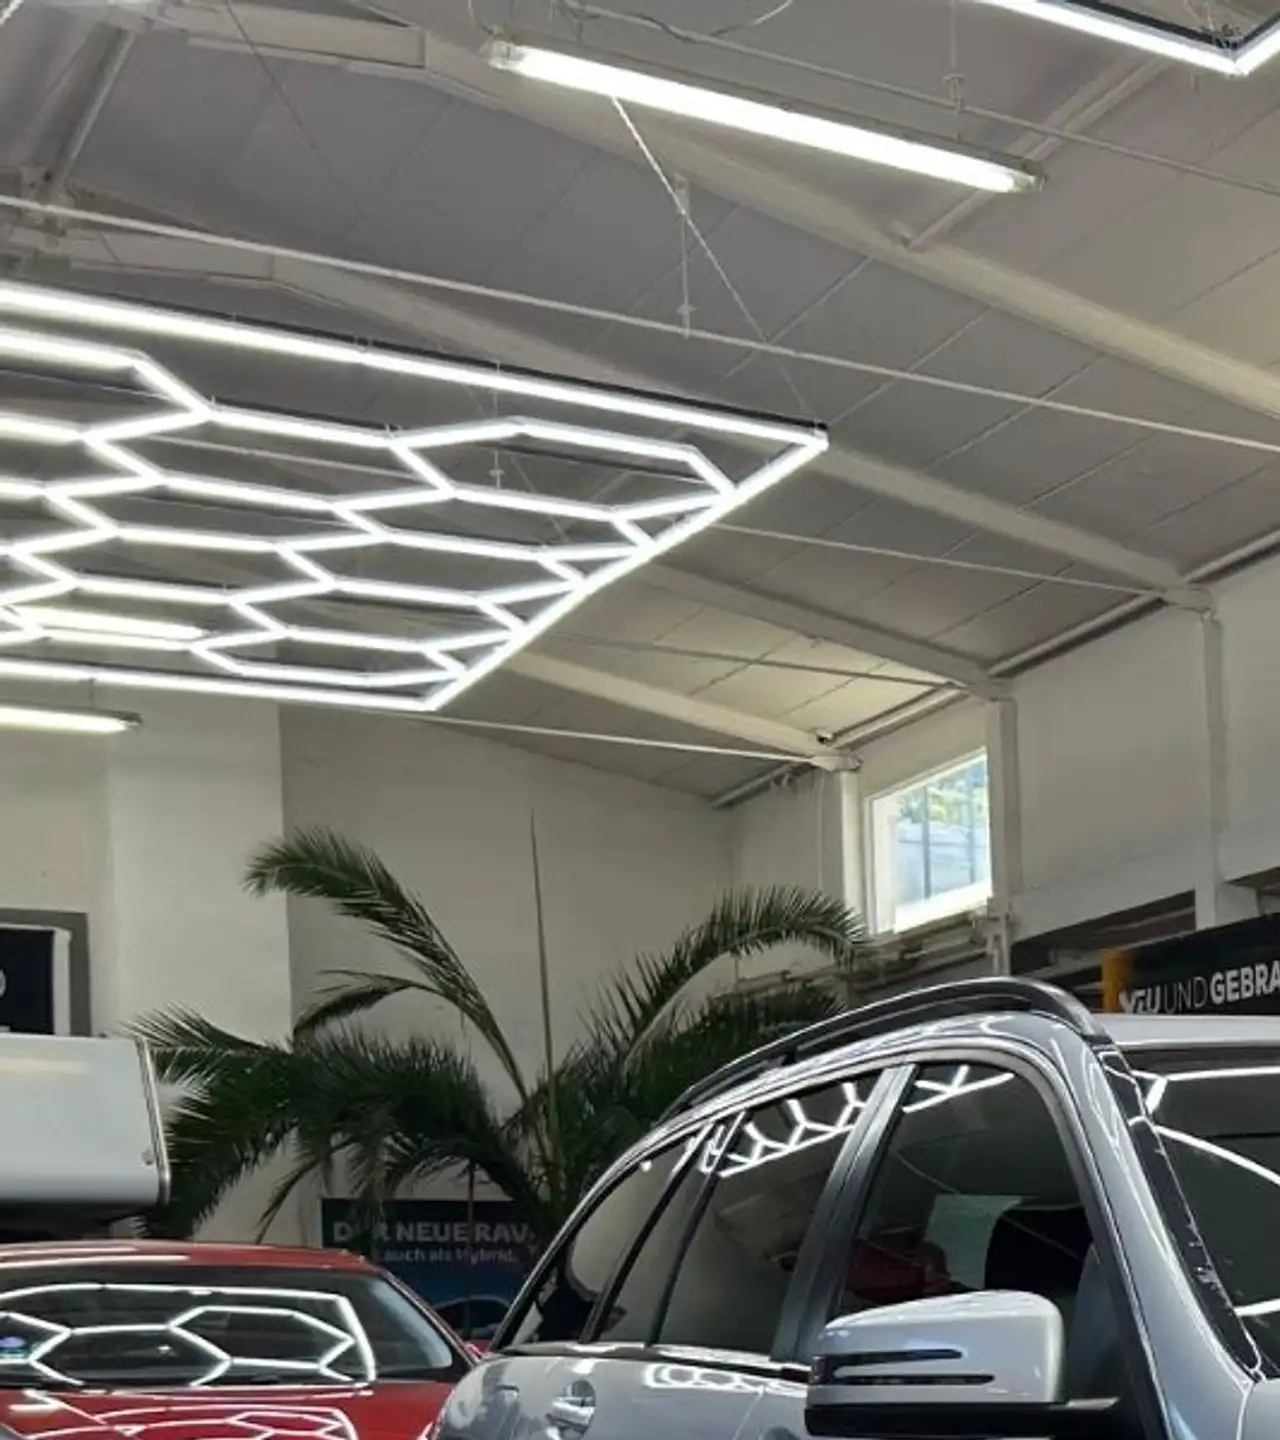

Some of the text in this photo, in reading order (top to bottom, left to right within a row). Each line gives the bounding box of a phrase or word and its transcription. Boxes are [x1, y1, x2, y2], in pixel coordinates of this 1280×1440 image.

[333, 1221, 536, 1243] DR NEUE RAV
